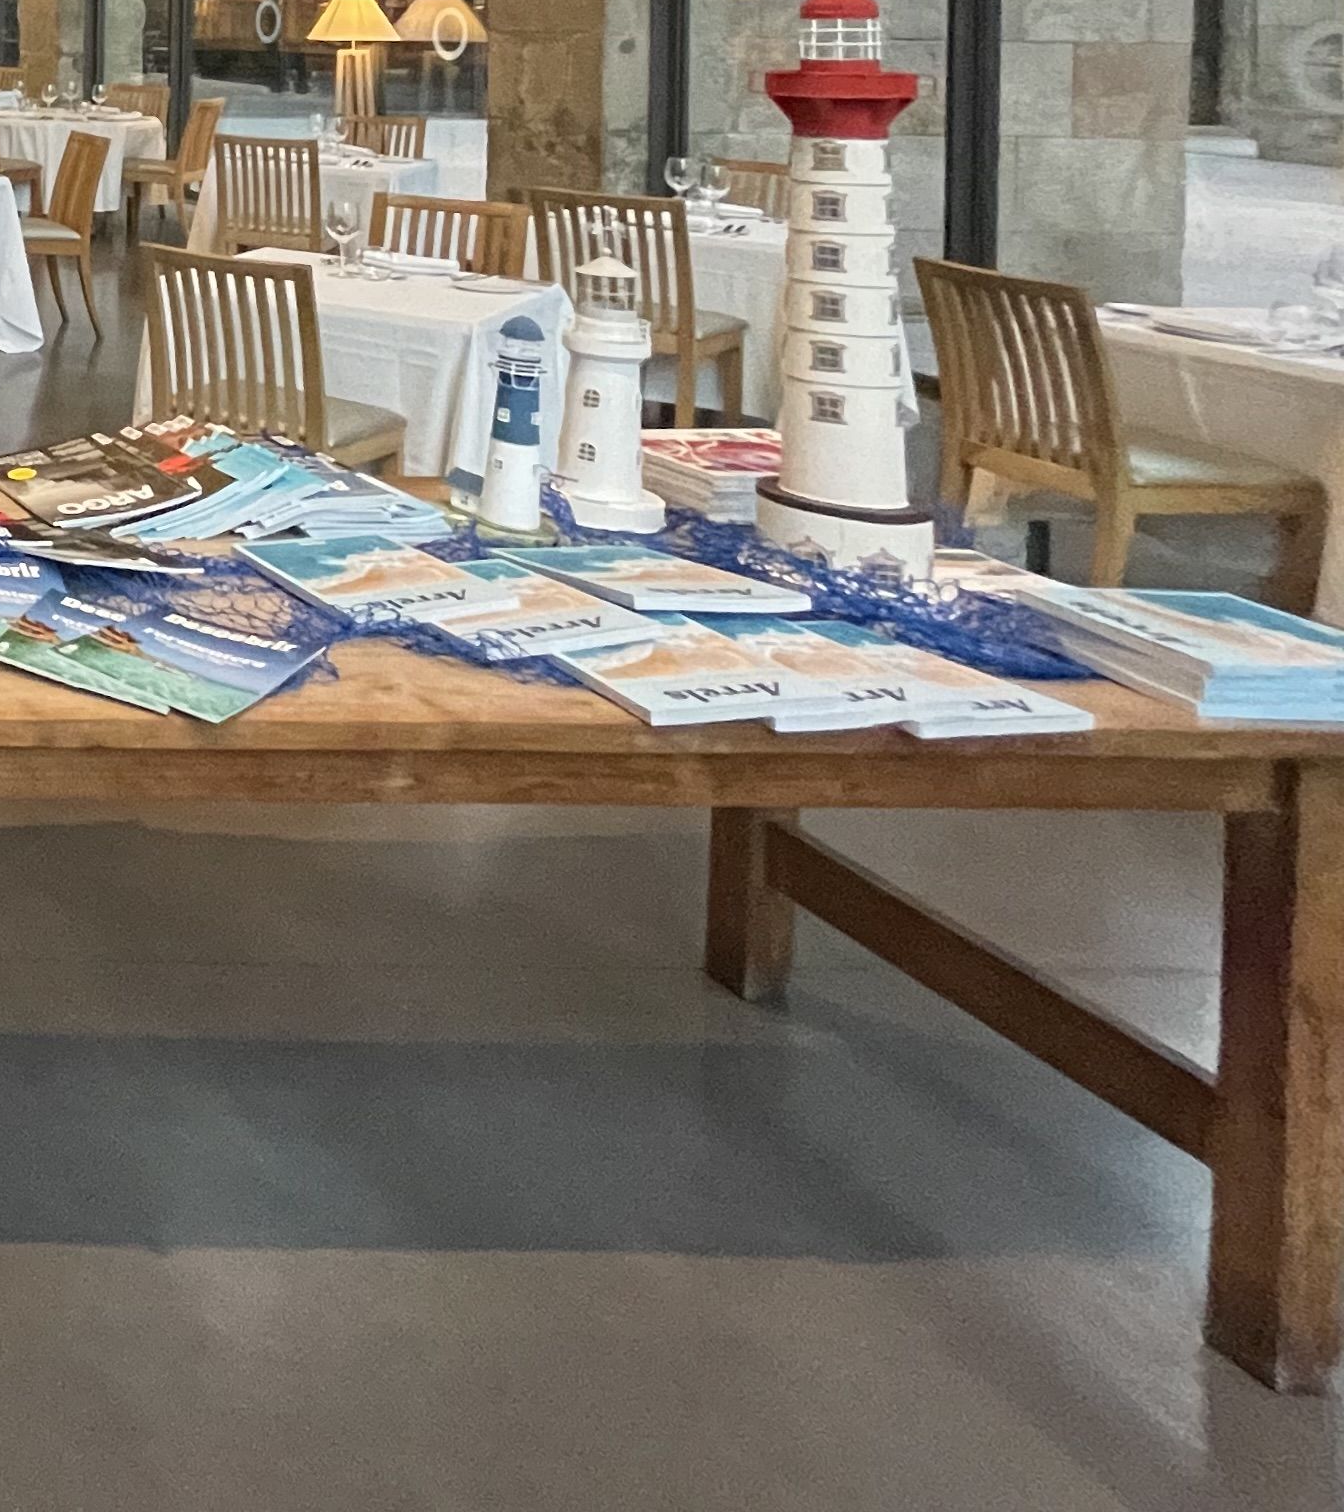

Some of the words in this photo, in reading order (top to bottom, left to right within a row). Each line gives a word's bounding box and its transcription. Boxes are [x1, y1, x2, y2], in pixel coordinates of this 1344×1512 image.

[56, 484, 155, 515] ARGO
[662, 681, 781, 704] Arrels
[841, 686, 907, 704] Arr
